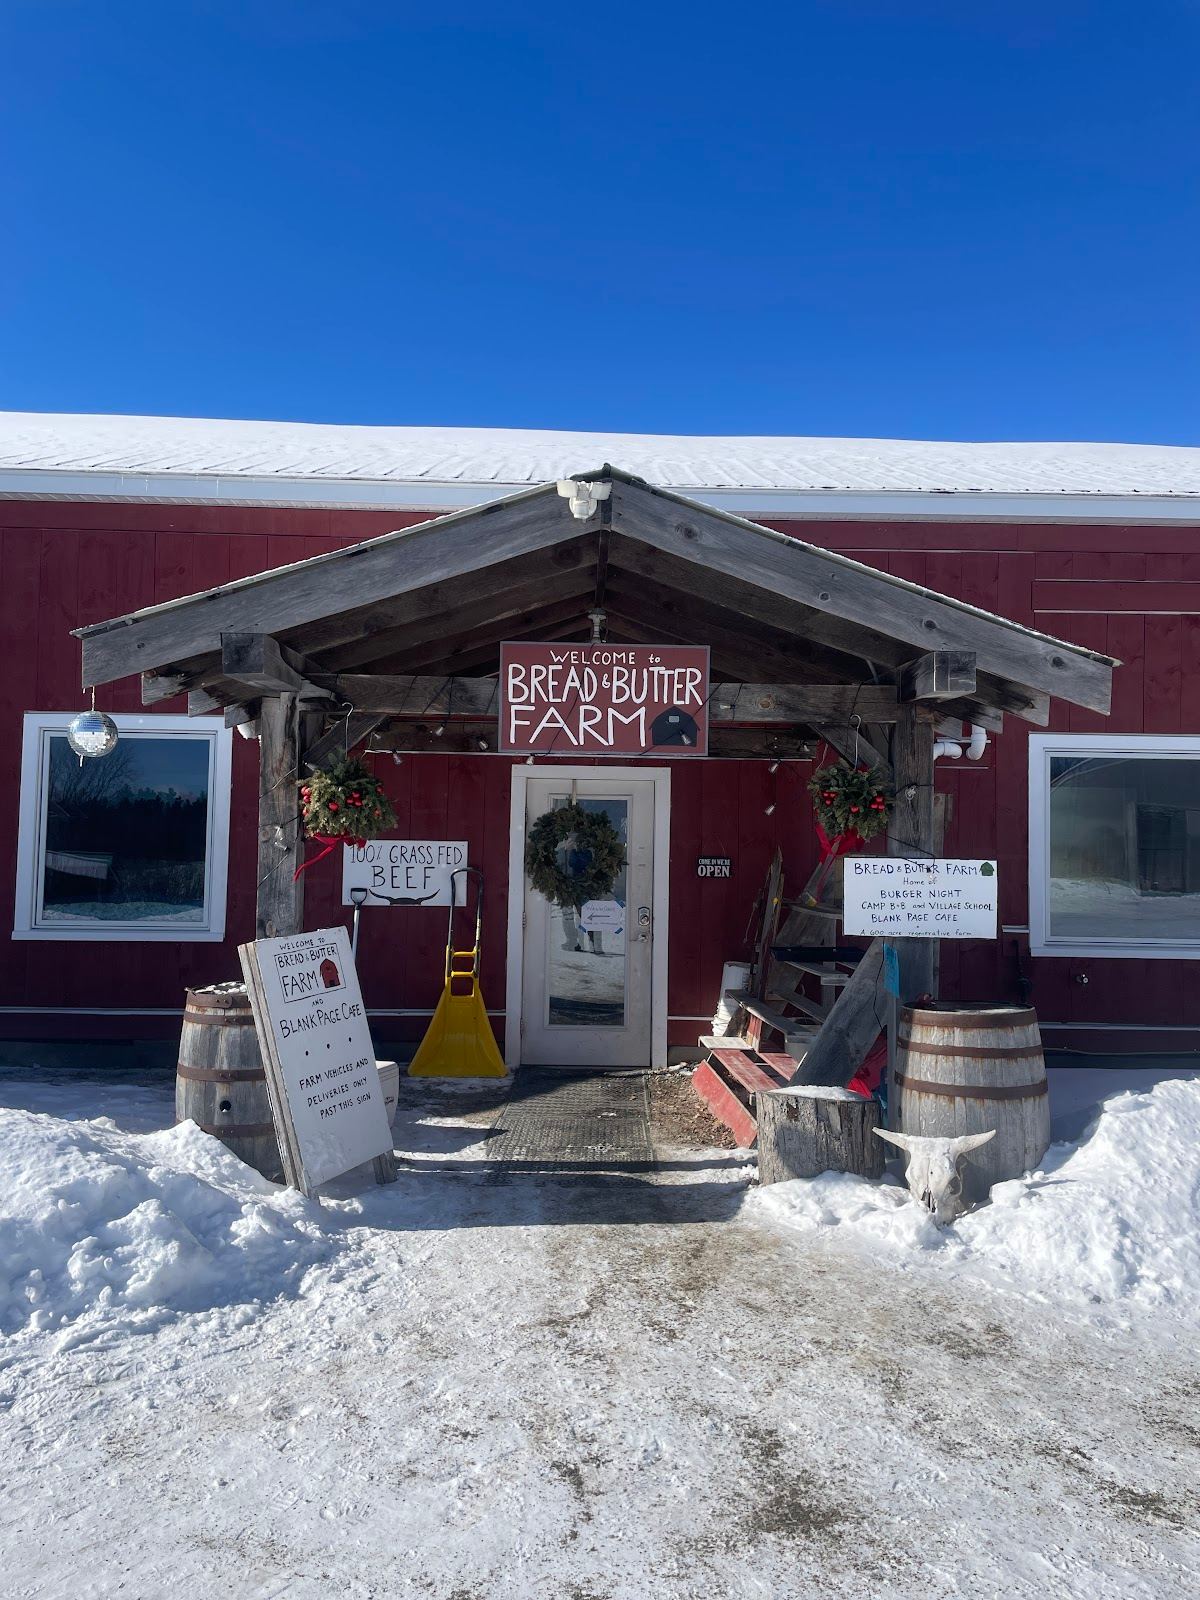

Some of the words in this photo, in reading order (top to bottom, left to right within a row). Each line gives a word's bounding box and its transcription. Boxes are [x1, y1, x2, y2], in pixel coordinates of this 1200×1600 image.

[550, 651, 636, 665] WELCOME
[648, 653, 661, 663] to
[507, 664, 598, 703] BREAD
[601, 674, 611, 689] &
[611, 666, 703, 705] BUTTER
[510, 705, 646, 747] FARM
[389, 845, 434, 864] GRASS
[438, 846, 463, 865] FED
[371, 865, 435, 889] BEEF
[698, 865, 730, 877] OPEN
[854, 863, 894, 875] BREAD
[903, 864, 940, 874] BUTTR
[946, 864, 978, 875] FARM
[903, 877, 925, 886] Home
[880, 890, 922, 898] BURGER
[928, 890, 962, 898] NIGHT
[861, 902, 886, 910] CAMP
[928, 902, 962, 910] VILLAGE
[964, 902, 994, 911] SCHOOL
[871, 914, 902, 923] BLANK
[907, 913, 928, 922] PAGE
[934, 914, 958, 922] CAFE
[280, 939, 314, 950] WELCOME
[278, 953, 304, 968] BREAD
[310, 946, 337, 961] BUTTER
[282, 970, 320, 998] FARM
[311, 998, 324, 1007] AND
[280, 1012, 318, 1038] BLANK
[316, 1008, 341, 1026] PAGE
[342, 1002, 362, 1020] CAFE
[300, 1074, 322, 1090] FARM
[324, 1064, 354, 1079] VEHICLES
[356, 1058, 368, 1069] AND
[308, 1084, 349, 1107] DELIVERIES
[353, 1076, 366, 1088] ONLY
[320, 1104, 337, 1119] PAST
[338, 1098, 354, 1110] THIS
[356, 1092, 371, 1104] SIGN
